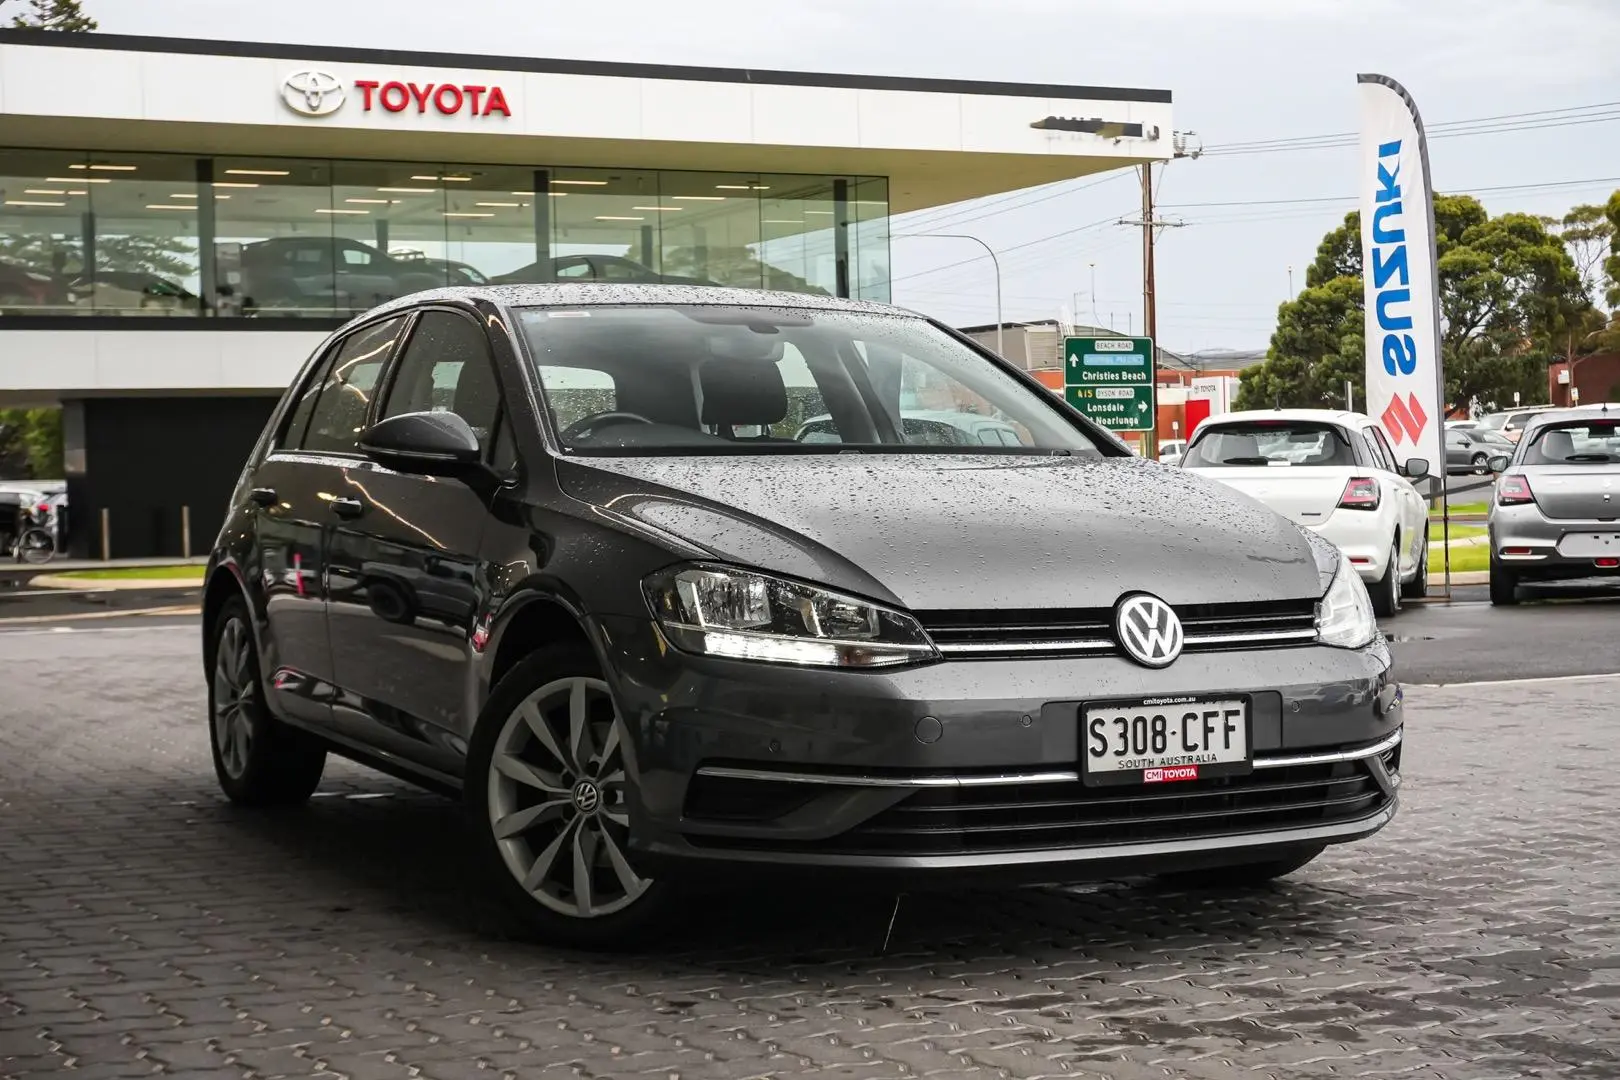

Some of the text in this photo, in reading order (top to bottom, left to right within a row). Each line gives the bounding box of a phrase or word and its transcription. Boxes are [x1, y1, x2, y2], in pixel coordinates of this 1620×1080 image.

[354, 80, 511, 116] TOYOTA
[1082, 371, 1146, 380] Christies Beach
[1077, 389, 1133, 398] A15 DYSON ROAD
[1200, 385, 1216, 393] TOYOTA
[1087, 403, 1124, 412] Lonsdale
[1096, 416, 1139, 427] Noarlunga
[1143, 696, 1196, 705] cmitoyota.com.au
[1118, 753, 1217, 769] SOUTH AUSTRALIA
[1146, 768, 1197, 780] CMI TOYOTA
